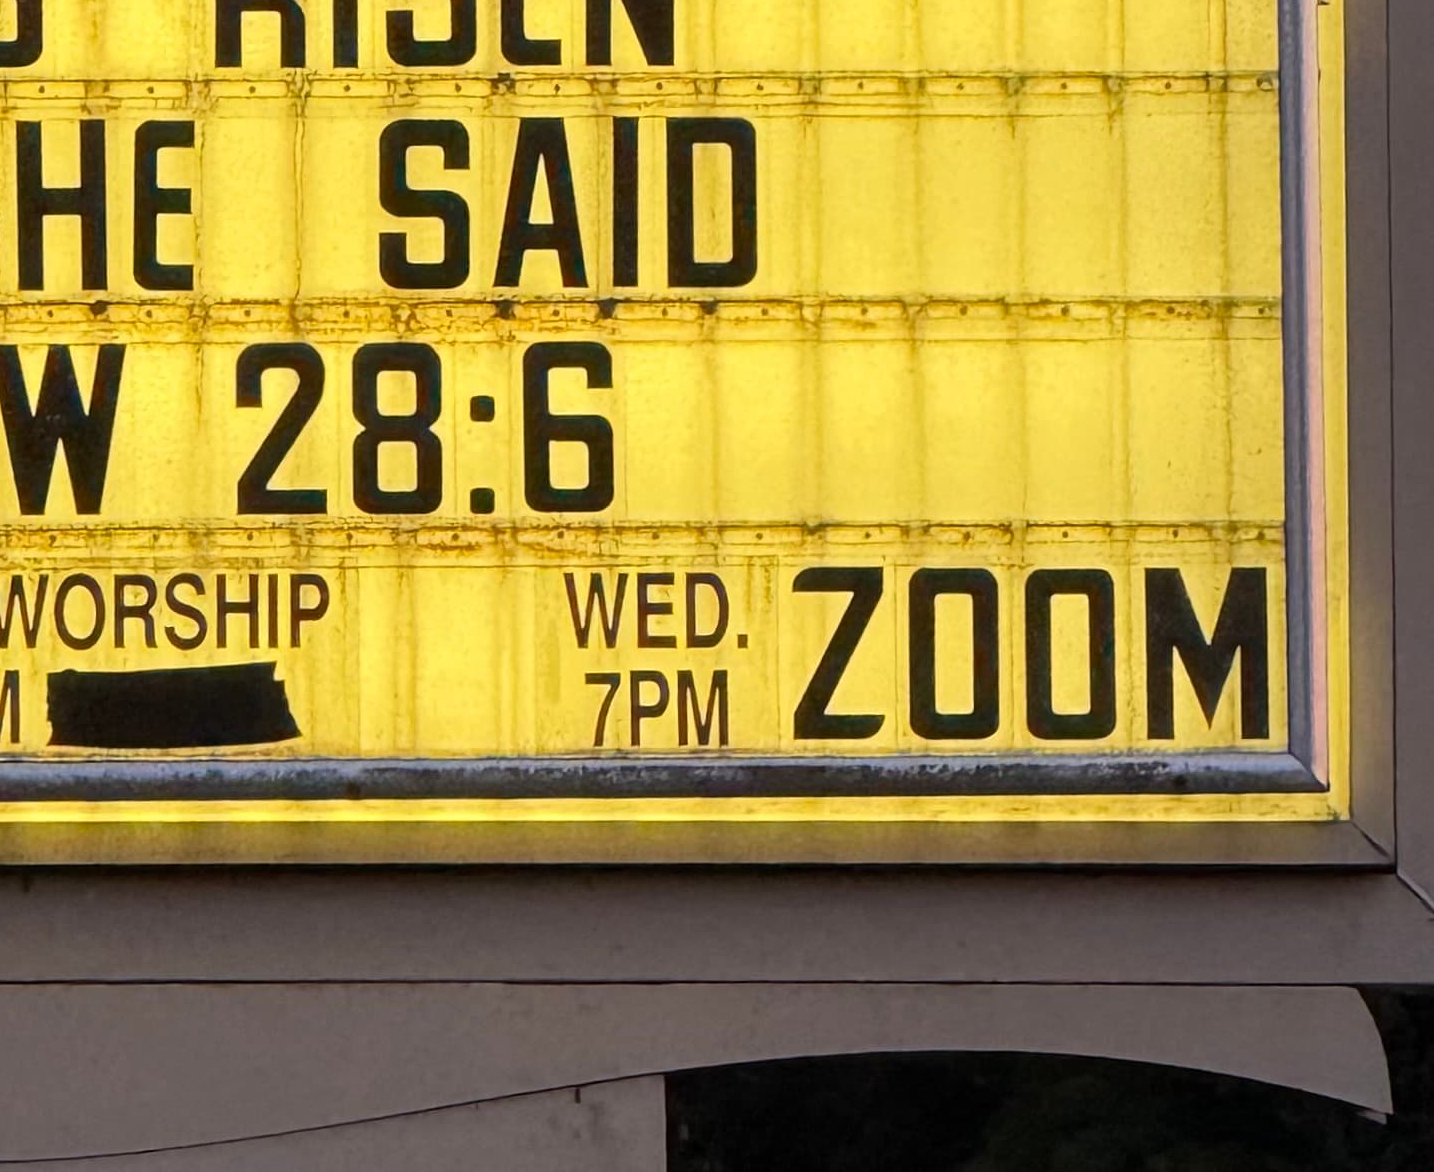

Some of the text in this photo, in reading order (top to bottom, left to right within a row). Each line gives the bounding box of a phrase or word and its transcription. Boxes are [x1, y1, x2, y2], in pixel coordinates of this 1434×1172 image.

[17, 118, 194, 291] HE
[380, 118, 757, 288] SAID
[236, 341, 613, 516] 28:6
[564, 571, 750, 650] WED.
[793, 567, 1269, 740] ZOOM
[585, 670, 729, 746] 7PM
